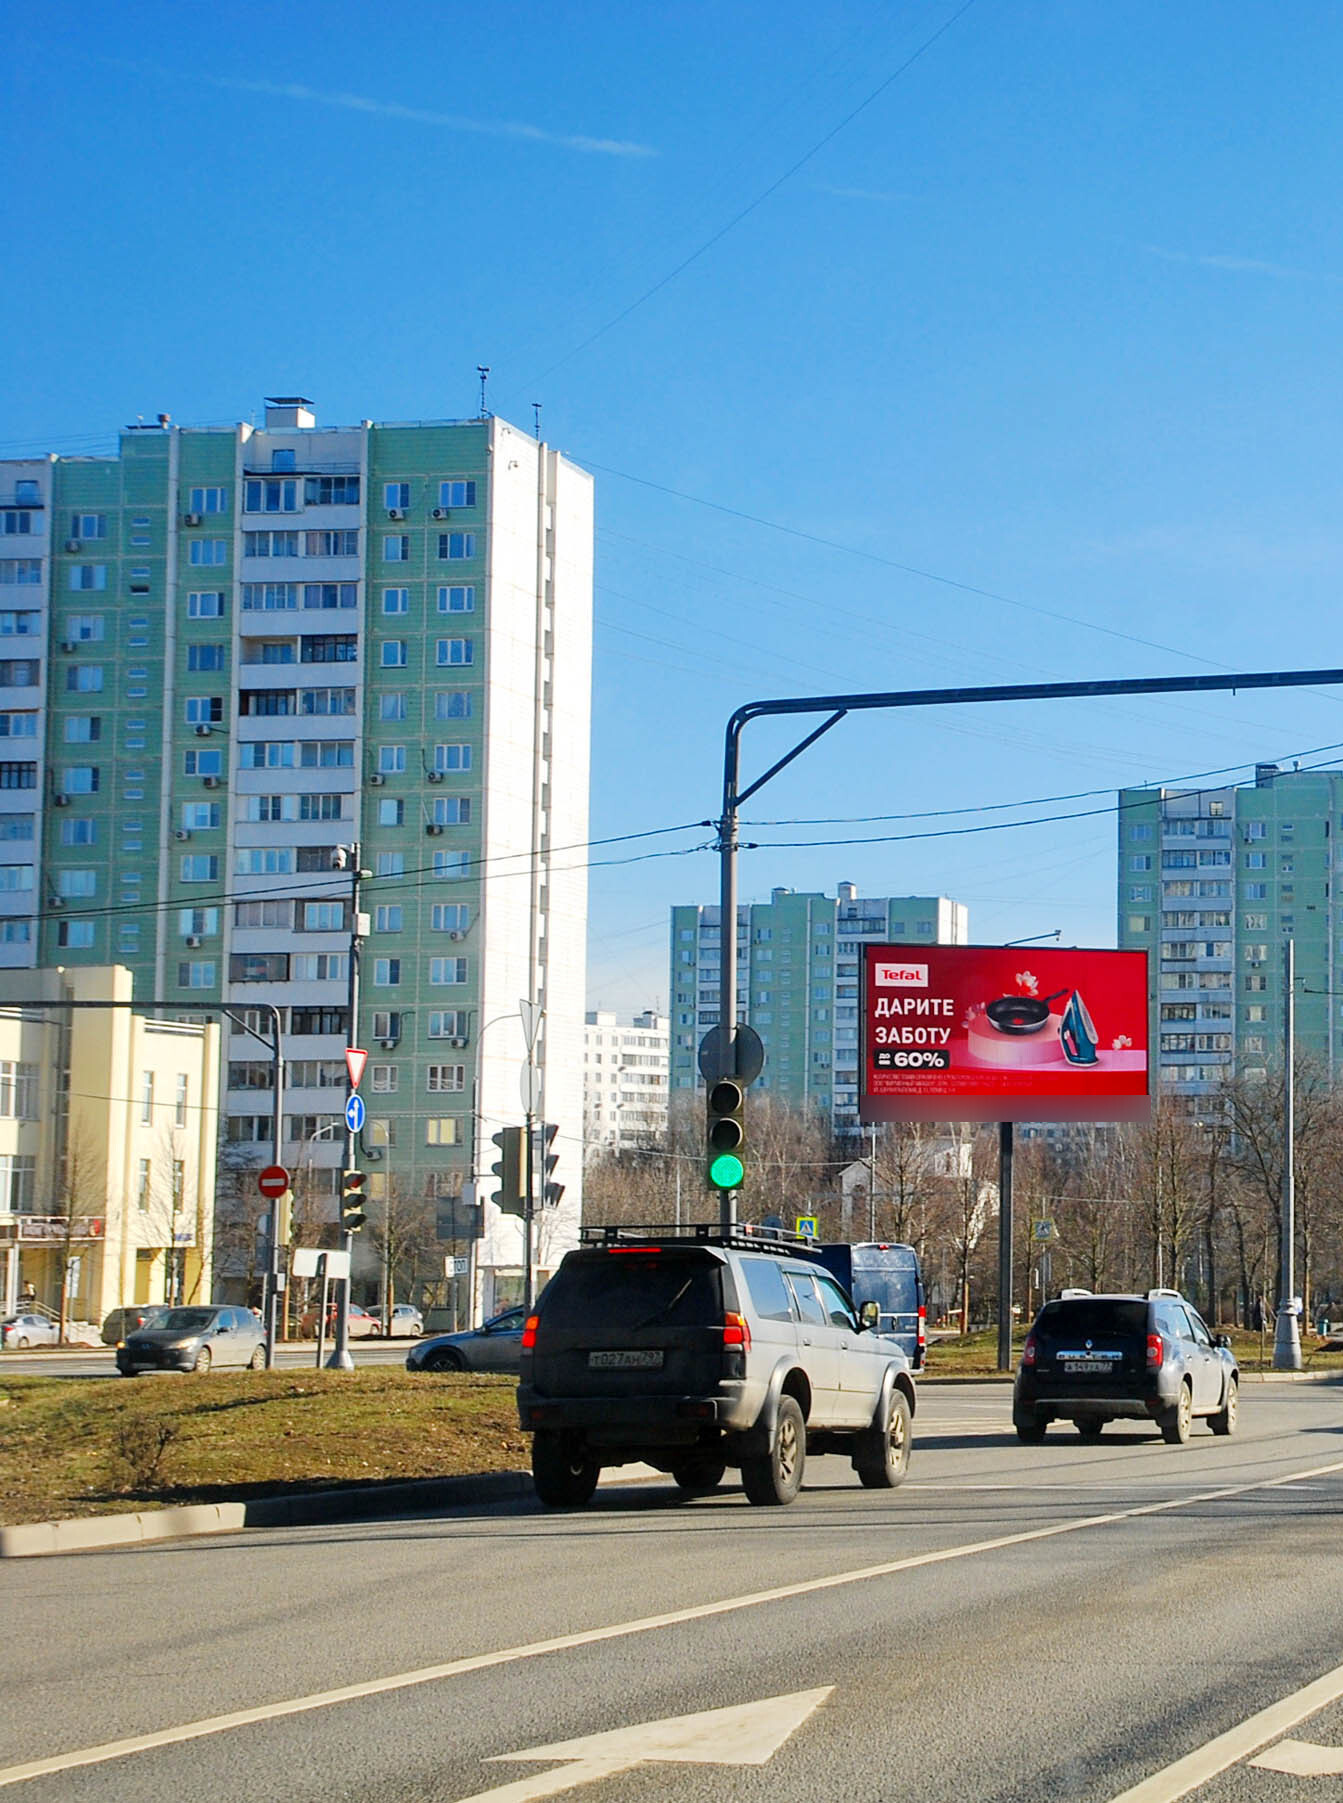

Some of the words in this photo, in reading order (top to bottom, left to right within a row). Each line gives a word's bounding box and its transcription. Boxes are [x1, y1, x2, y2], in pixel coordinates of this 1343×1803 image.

[881, 969, 922, 981] Tefal
[874, 998, 955, 1018] ДАРИТЕ
[875, 1027, 951, 1045] ЗАБОТУ
